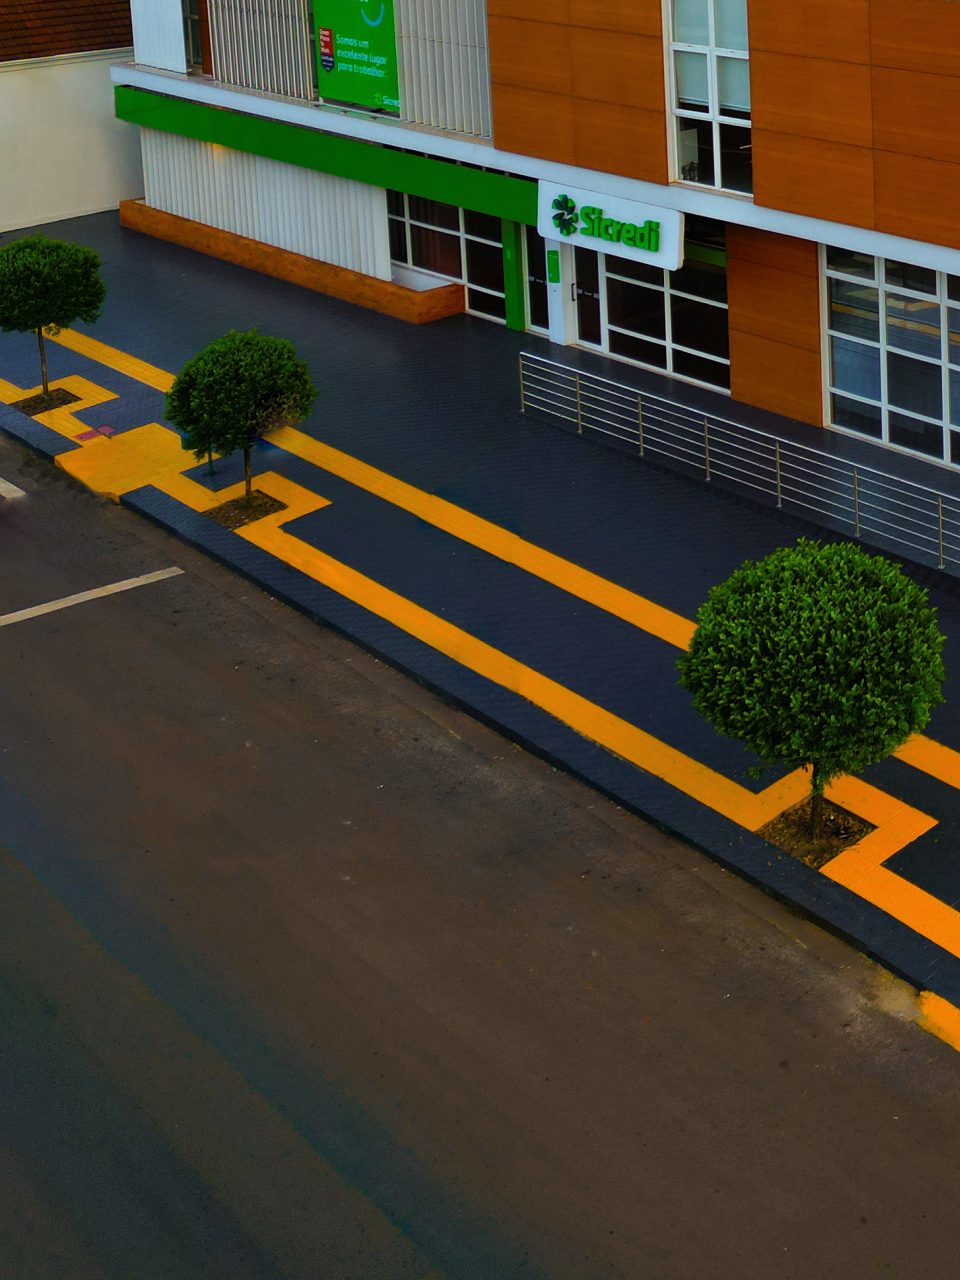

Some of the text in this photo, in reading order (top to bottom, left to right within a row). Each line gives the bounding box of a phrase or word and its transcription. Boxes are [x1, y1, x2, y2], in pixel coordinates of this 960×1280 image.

[336, 34, 357, 46] Somos
[337, 62, 353, 72] para
[580, 206, 660, 252] Sicredi
